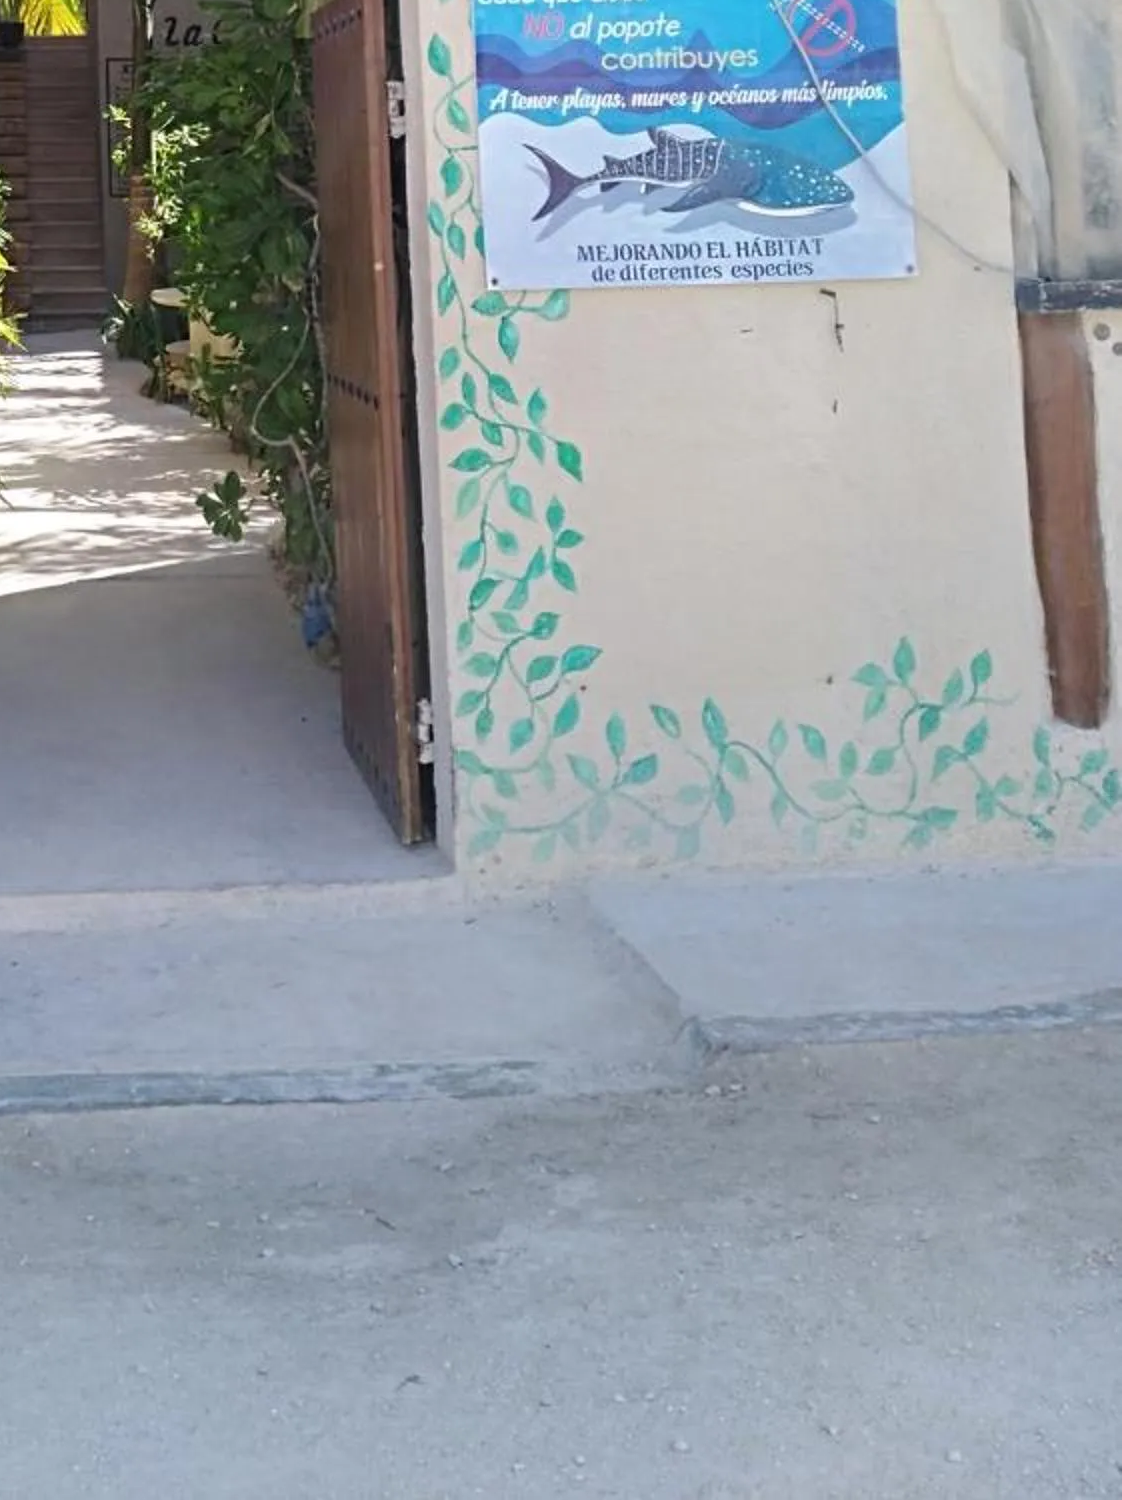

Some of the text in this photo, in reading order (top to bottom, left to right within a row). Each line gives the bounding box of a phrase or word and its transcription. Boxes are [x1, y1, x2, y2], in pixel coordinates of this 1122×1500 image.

[523, 10, 680, 45] NO al popote
[601, 47, 759, 74] contribuyes
[488, 87, 509, 111] A
[510, 89, 559, 110] tener
[631, 91, 687, 108] mares
[691, 90, 706, 113] y
[708, 84, 779, 106] océanos
[781, 81, 817, 103] más
[577, 236, 825, 262] MEJORANDO EL HÁBITAT
[591, 259, 815, 282] de diferentes especies
